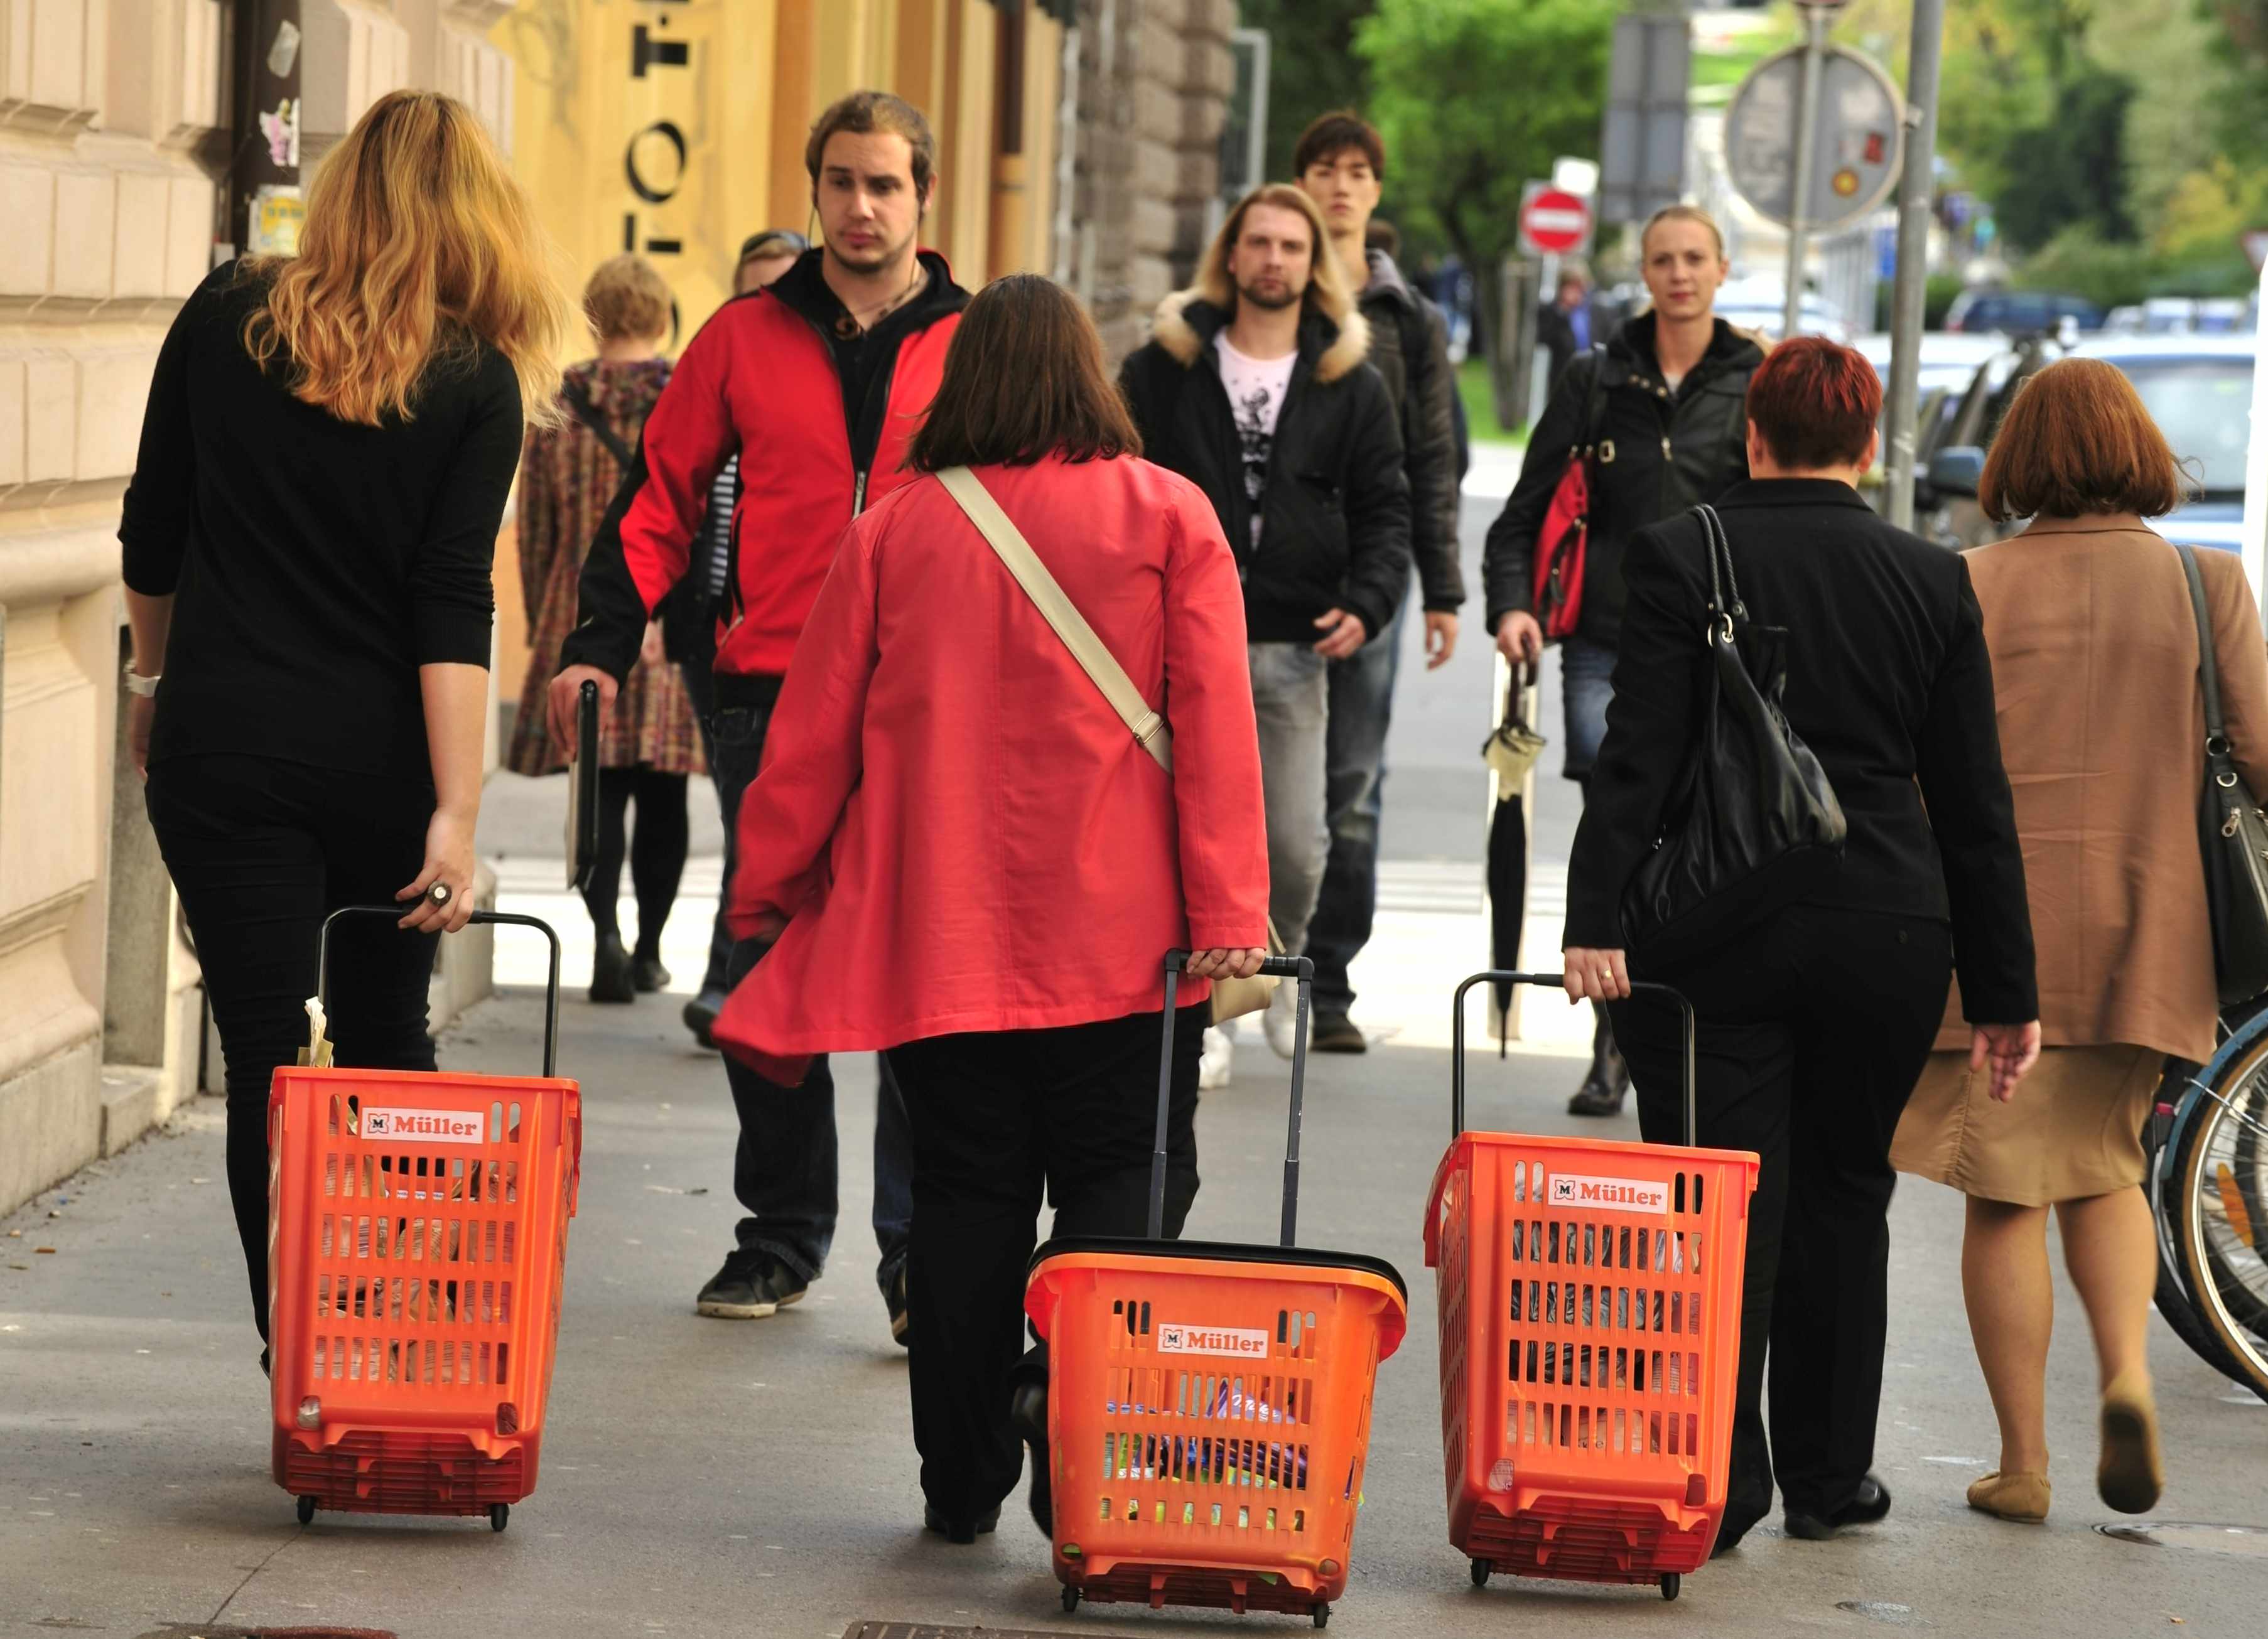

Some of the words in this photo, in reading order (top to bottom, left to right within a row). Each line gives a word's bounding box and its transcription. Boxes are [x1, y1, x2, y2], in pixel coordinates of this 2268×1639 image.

[393, 1115, 477, 1136] Müller
[1580, 1183, 1662, 1206] Müller
[1187, 1331, 1265, 1352] Müller
